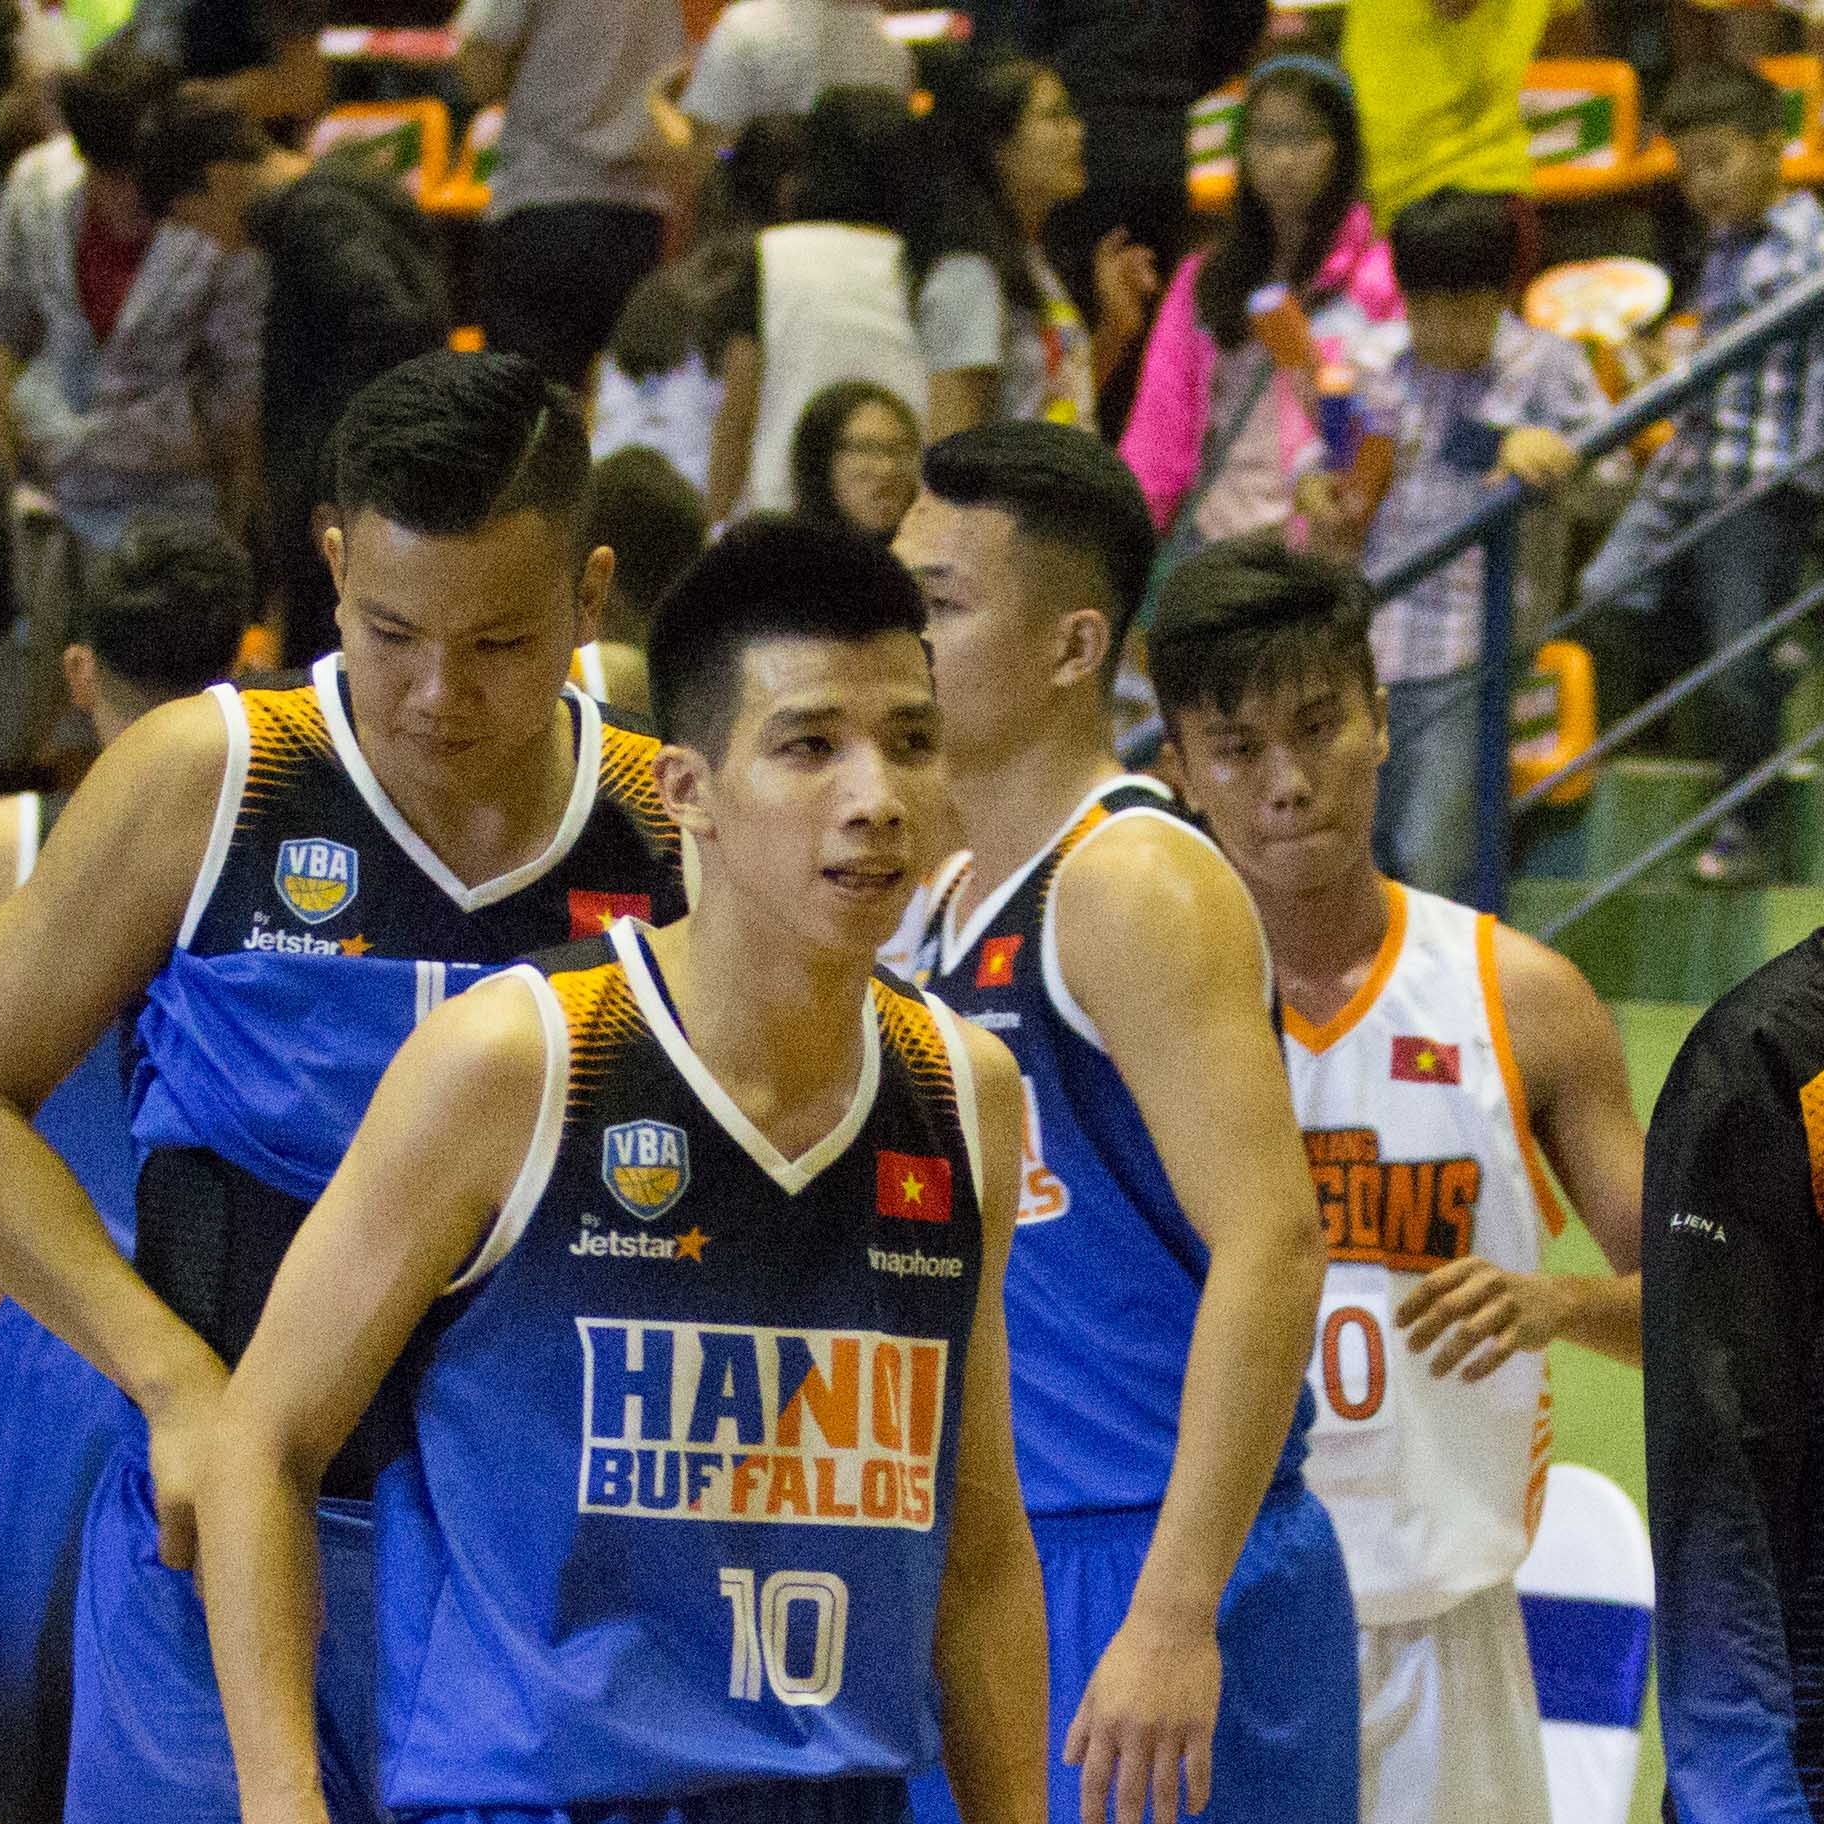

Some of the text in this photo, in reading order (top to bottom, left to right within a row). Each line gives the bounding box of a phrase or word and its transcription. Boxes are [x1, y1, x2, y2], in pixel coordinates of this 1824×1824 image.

[288, 844, 348, 881] VBA
[244, 927, 340, 956] Jetstar
[612, 1127, 679, 1166] VBA
[1312, 1158, 1480, 1260] GONS
[569, 1230, 676, 1259] Jetstar
[1322, 1306, 1385, 1422] 0
[719, 1567, 849, 1707] 10
